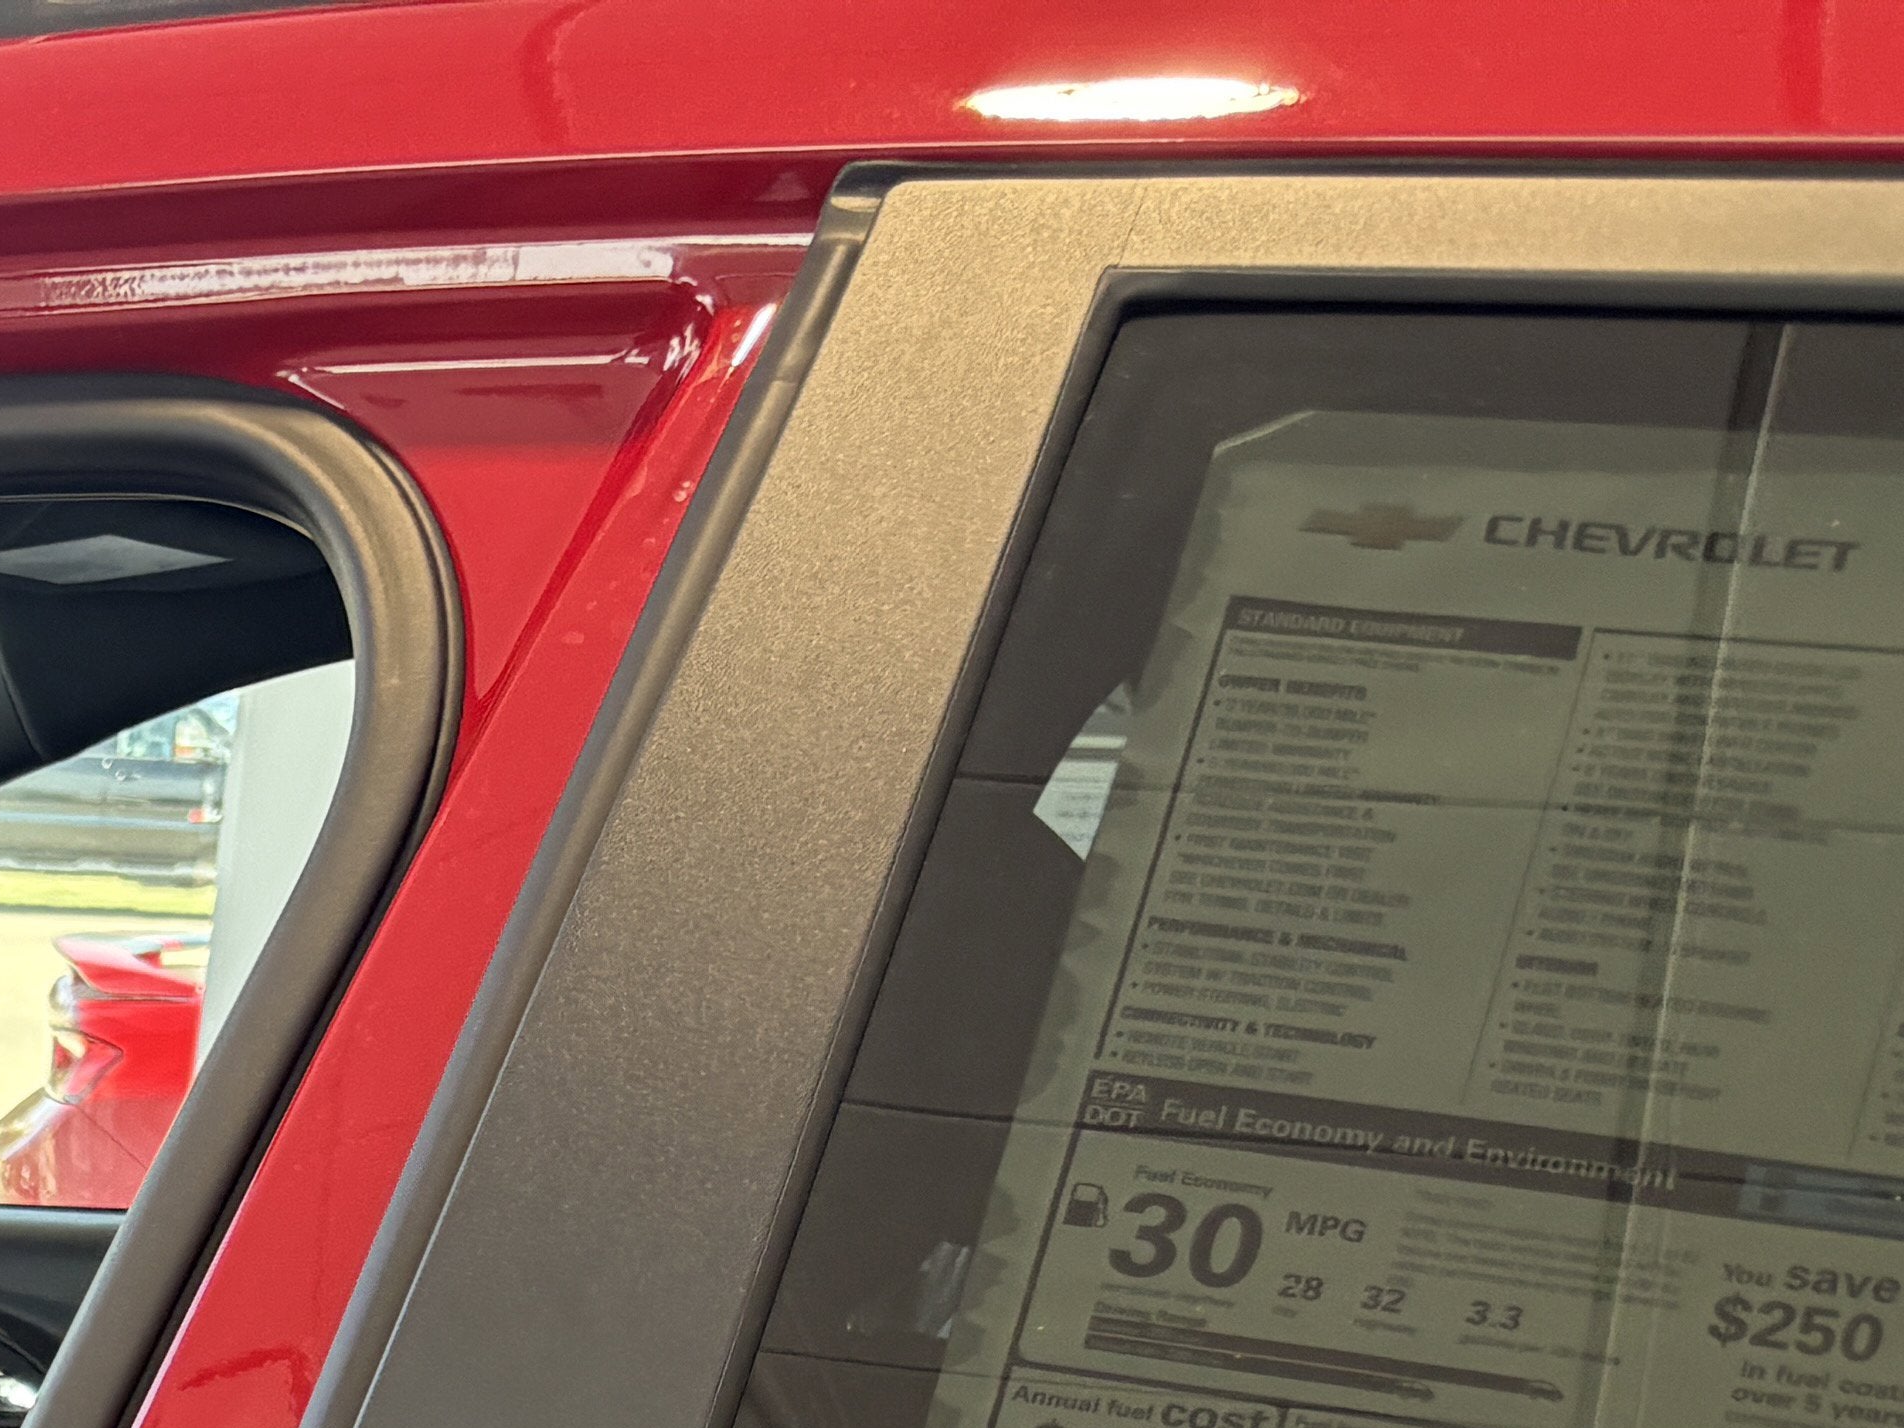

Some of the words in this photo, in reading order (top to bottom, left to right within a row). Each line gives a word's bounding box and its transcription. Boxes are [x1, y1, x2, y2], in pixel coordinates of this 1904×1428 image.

[1484, 513, 1862, 574] CHEVROLET
[1237, 607, 1344, 634] STANDARD
[1091, 1079, 1146, 1103] EPA
[1085, 1106, 1144, 1128] DOT
[1160, 1097, 1228, 1130] Fuel
[1235, 1109, 1386, 1154] Economy
[1393, 1133, 1457, 1159] and
[1465, 1137, 1678, 1191] Environment
[1134, 1164, 1176, 1184] Fuel
[1108, 1192, 1264, 1289] 30
[1285, 1211, 1367, 1243] MPG
[1277, 1273, 1324, 1301] 28
[1360, 1284, 1407, 1314] 32
[1723, 1263, 1773, 1287] You
[1783, 1265, 1901, 1304] save
[1466, 1300, 1524, 1332] 3.3
[1708, 1293, 1883, 1362] $250
[1741, 1361, 1767, 1380] in
[1776, 1365, 1830, 1389] fuel
[1839, 1379, 1904, 1403] cost
[1010, 1385, 1101, 1413] Annual
[1107, 1395, 1154, 1422] fuel
[1804, 1393, 1822, 1413] 5
